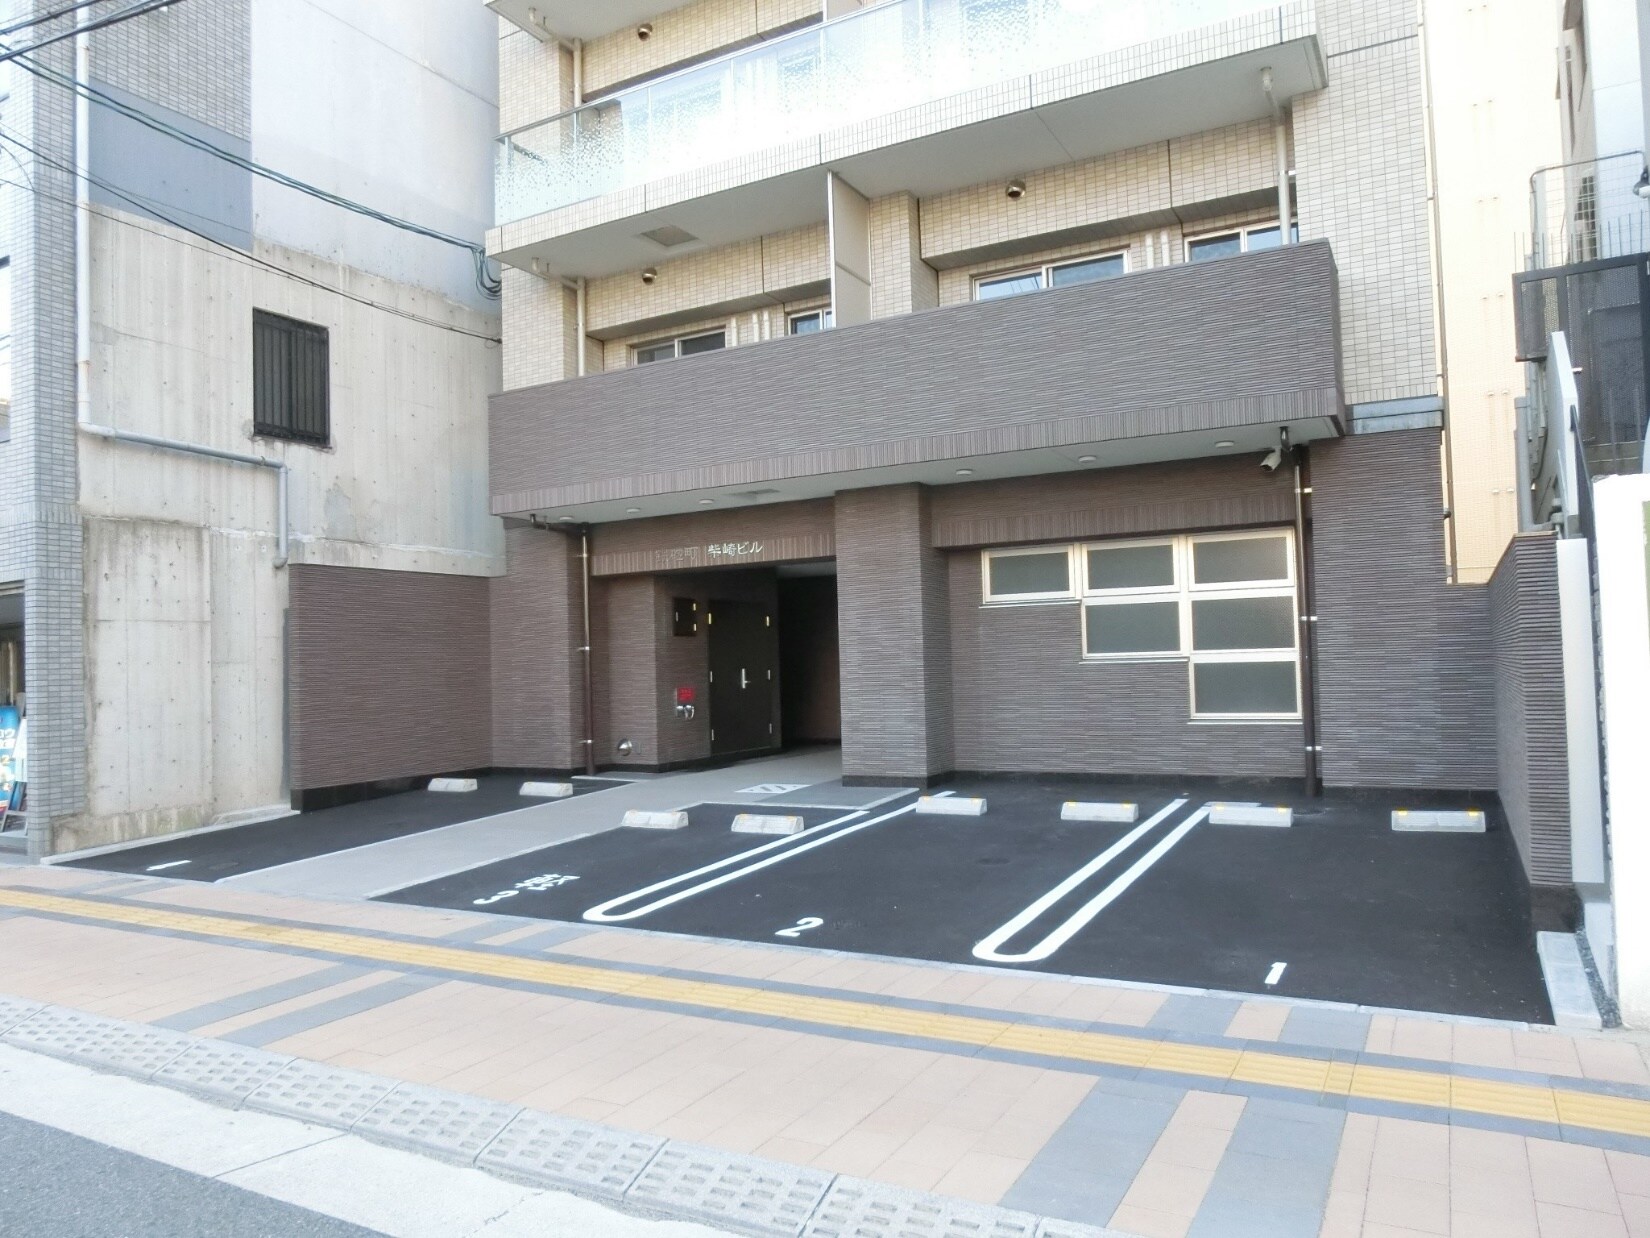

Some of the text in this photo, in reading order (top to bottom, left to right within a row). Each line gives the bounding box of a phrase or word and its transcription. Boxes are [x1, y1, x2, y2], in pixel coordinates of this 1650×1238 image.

[473, 890, 520, 905] 3
[774, 916, 824, 937] 2
[1264, 961, 1288, 985] 1
